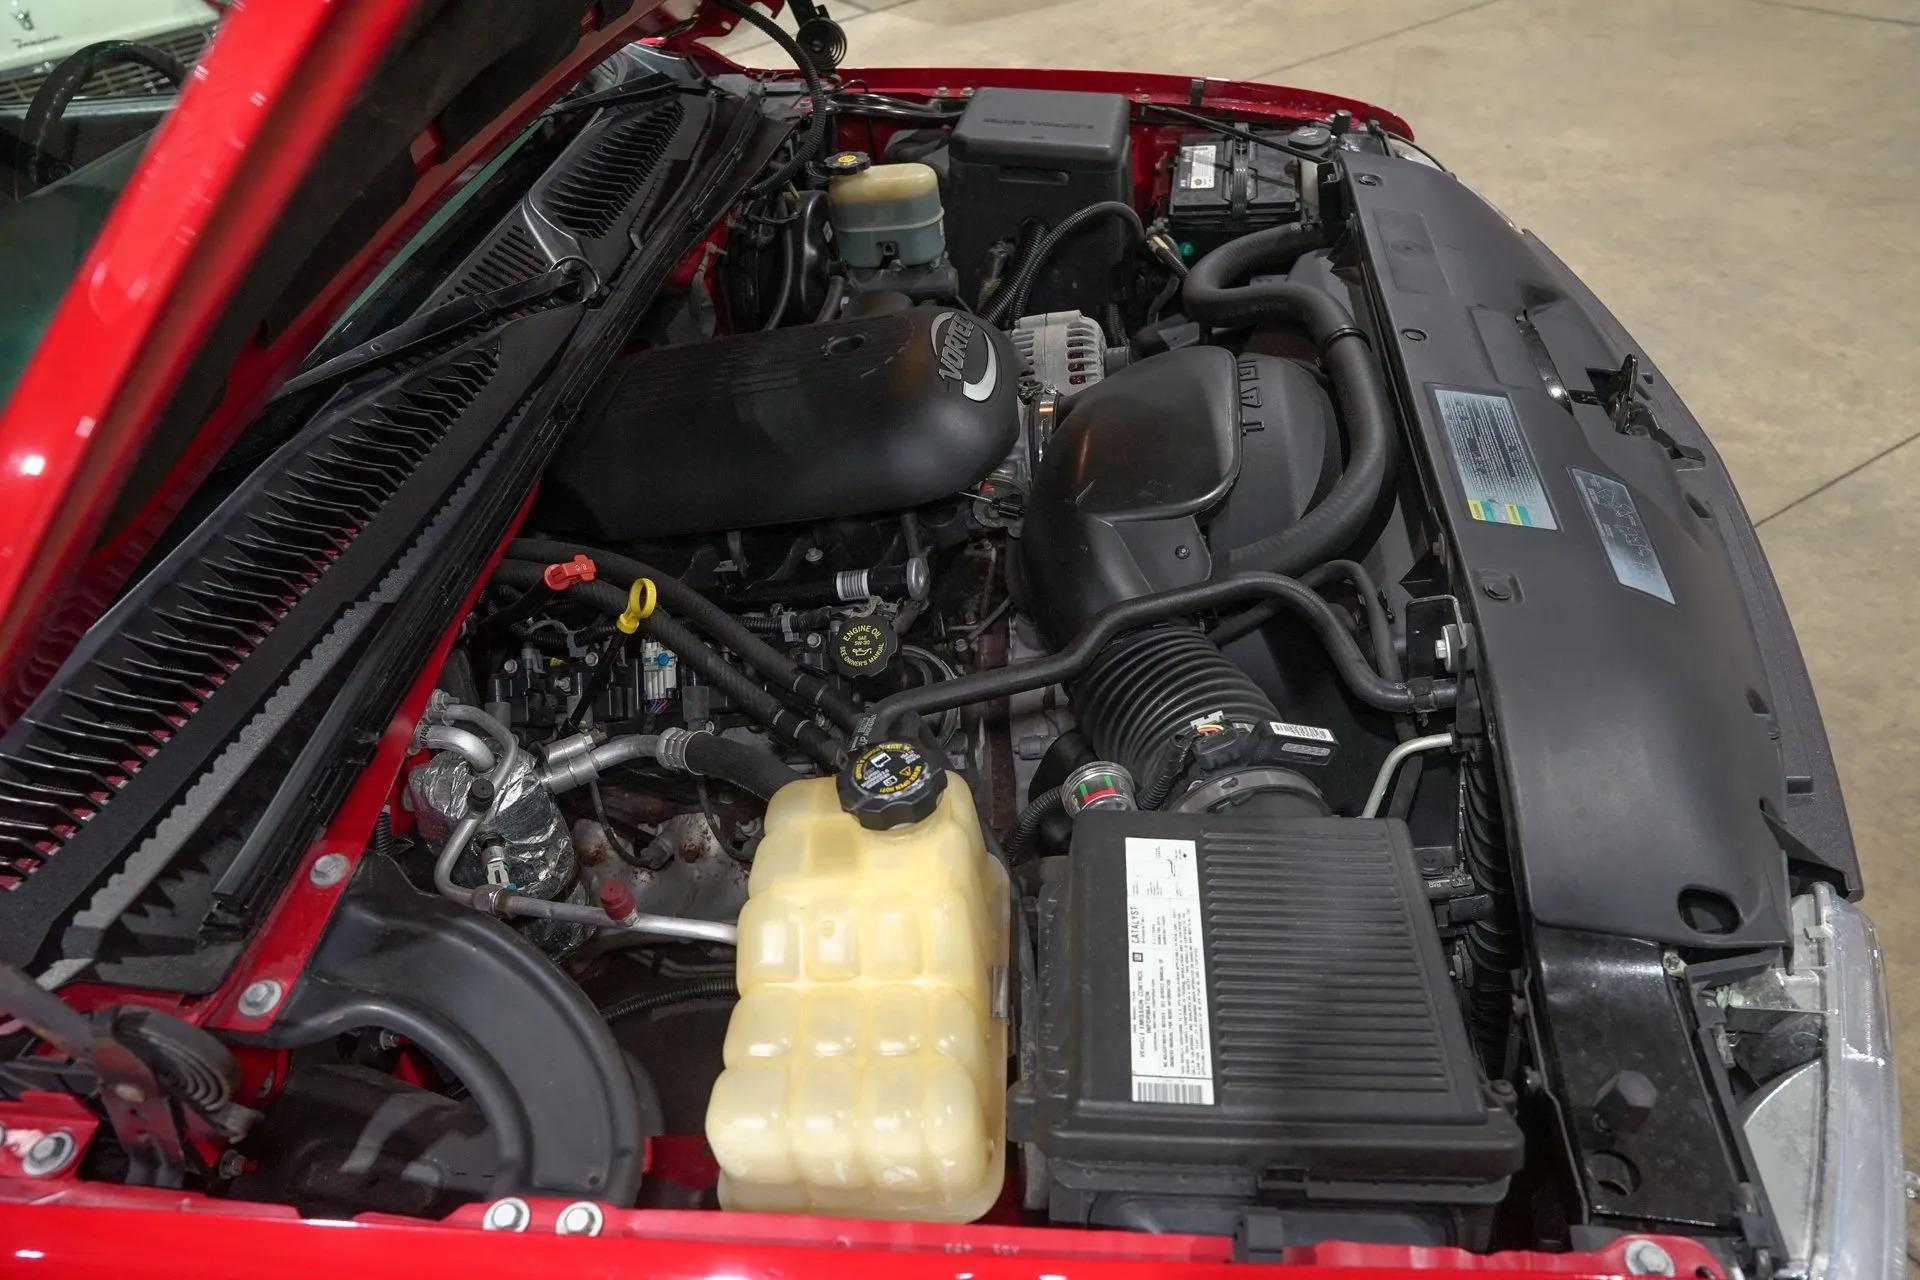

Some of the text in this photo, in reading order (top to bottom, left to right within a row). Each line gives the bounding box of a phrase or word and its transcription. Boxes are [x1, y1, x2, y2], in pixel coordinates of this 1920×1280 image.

[938, 313, 975, 381] VORTEC
[843, 625, 882, 642] ENGINE OIL
[868, 642, 885, 663] MANUAL
[1130, 906, 1140, 944] CATALYST
